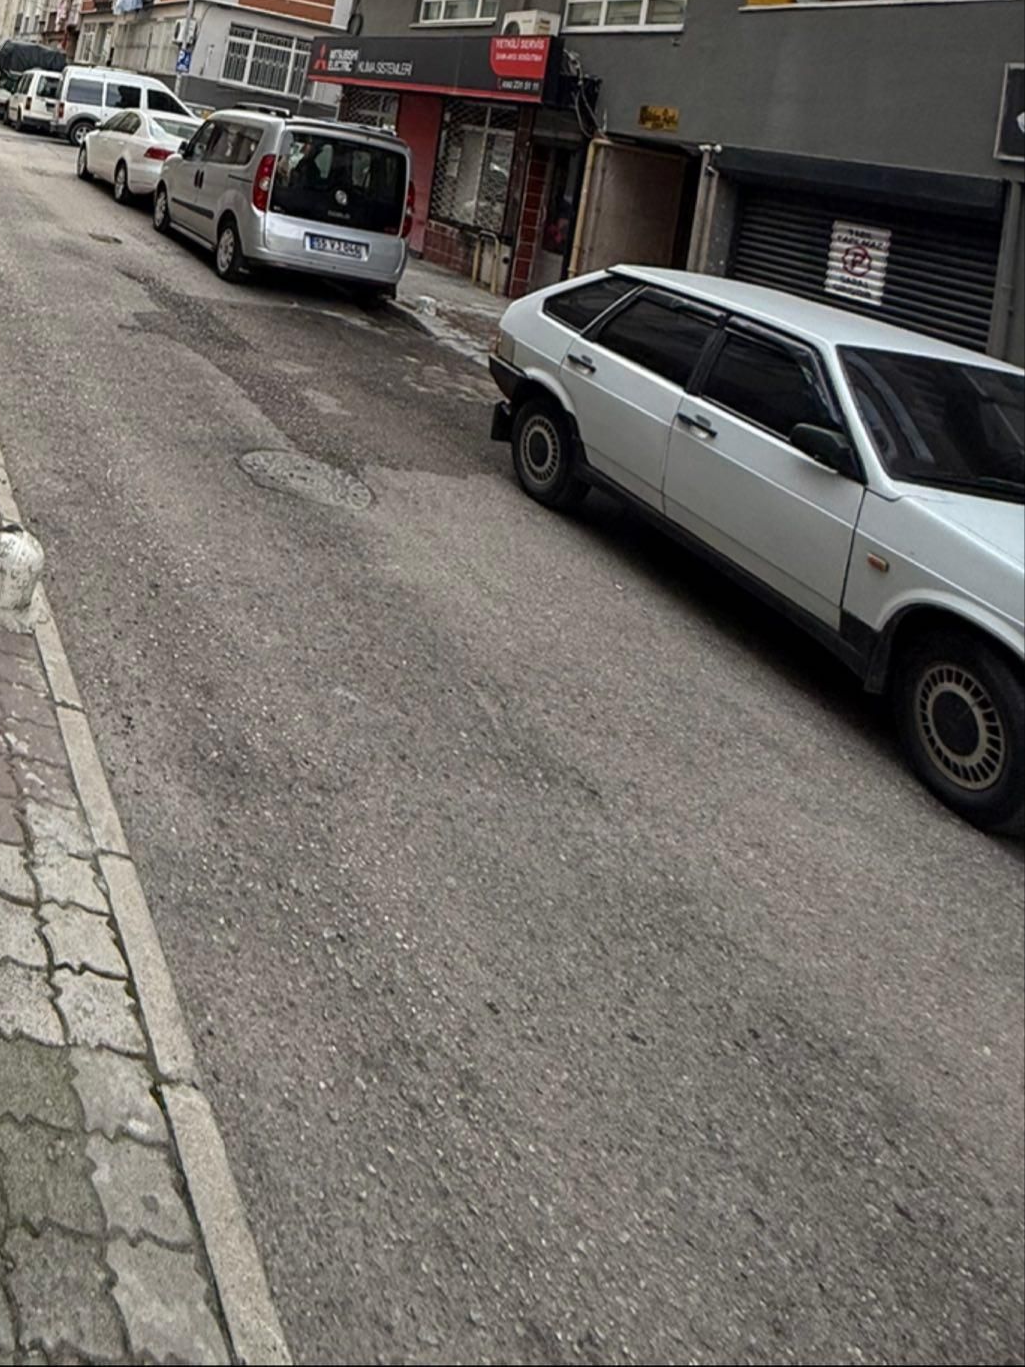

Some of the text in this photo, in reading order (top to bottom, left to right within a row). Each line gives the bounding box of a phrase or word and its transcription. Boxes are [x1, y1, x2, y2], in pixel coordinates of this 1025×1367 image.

[521, 37, 545, 50] SERVİS
[329, 49, 359, 61] MITSUBISHI
[328, 60, 353, 72] ELECTRIC
